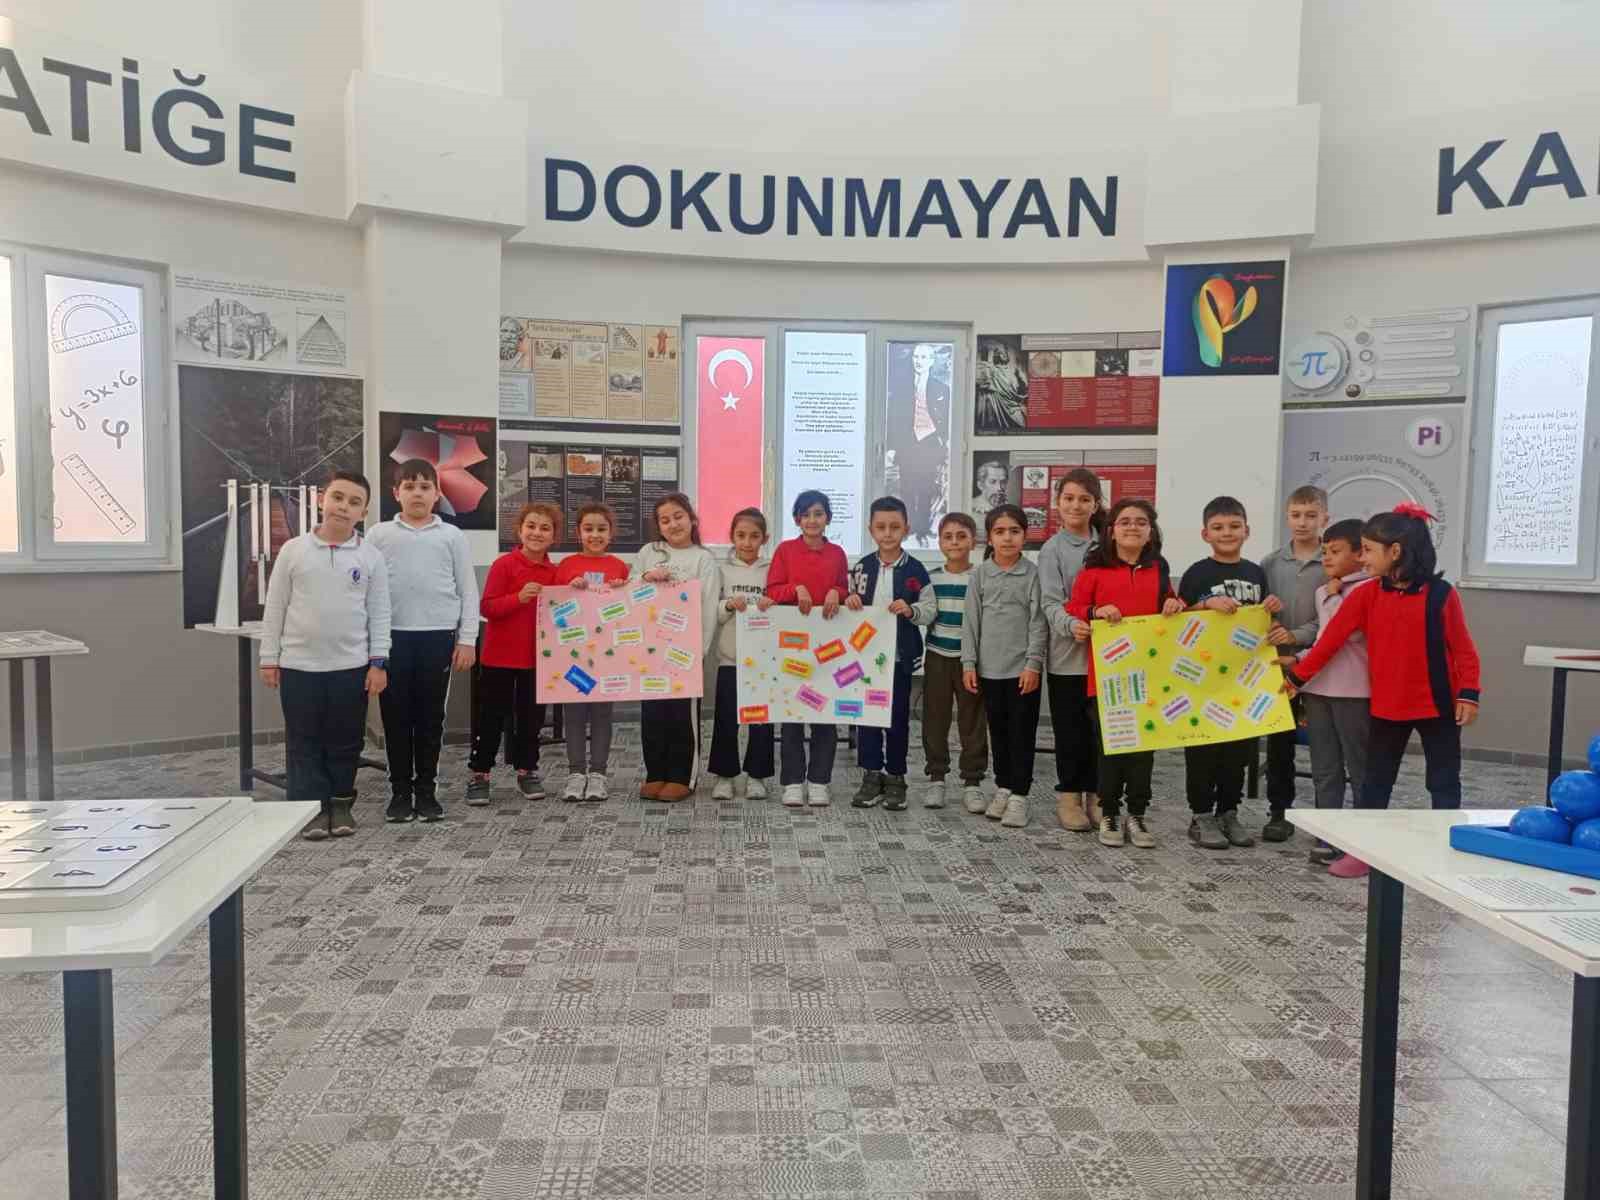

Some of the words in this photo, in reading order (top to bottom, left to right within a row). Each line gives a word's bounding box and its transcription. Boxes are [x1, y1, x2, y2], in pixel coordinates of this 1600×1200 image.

[545, 158, 1119, 239] DOKUNMAYAN
[1436, 131, 1600, 215] KA
[1417, 426, 1441, 446] Pi
